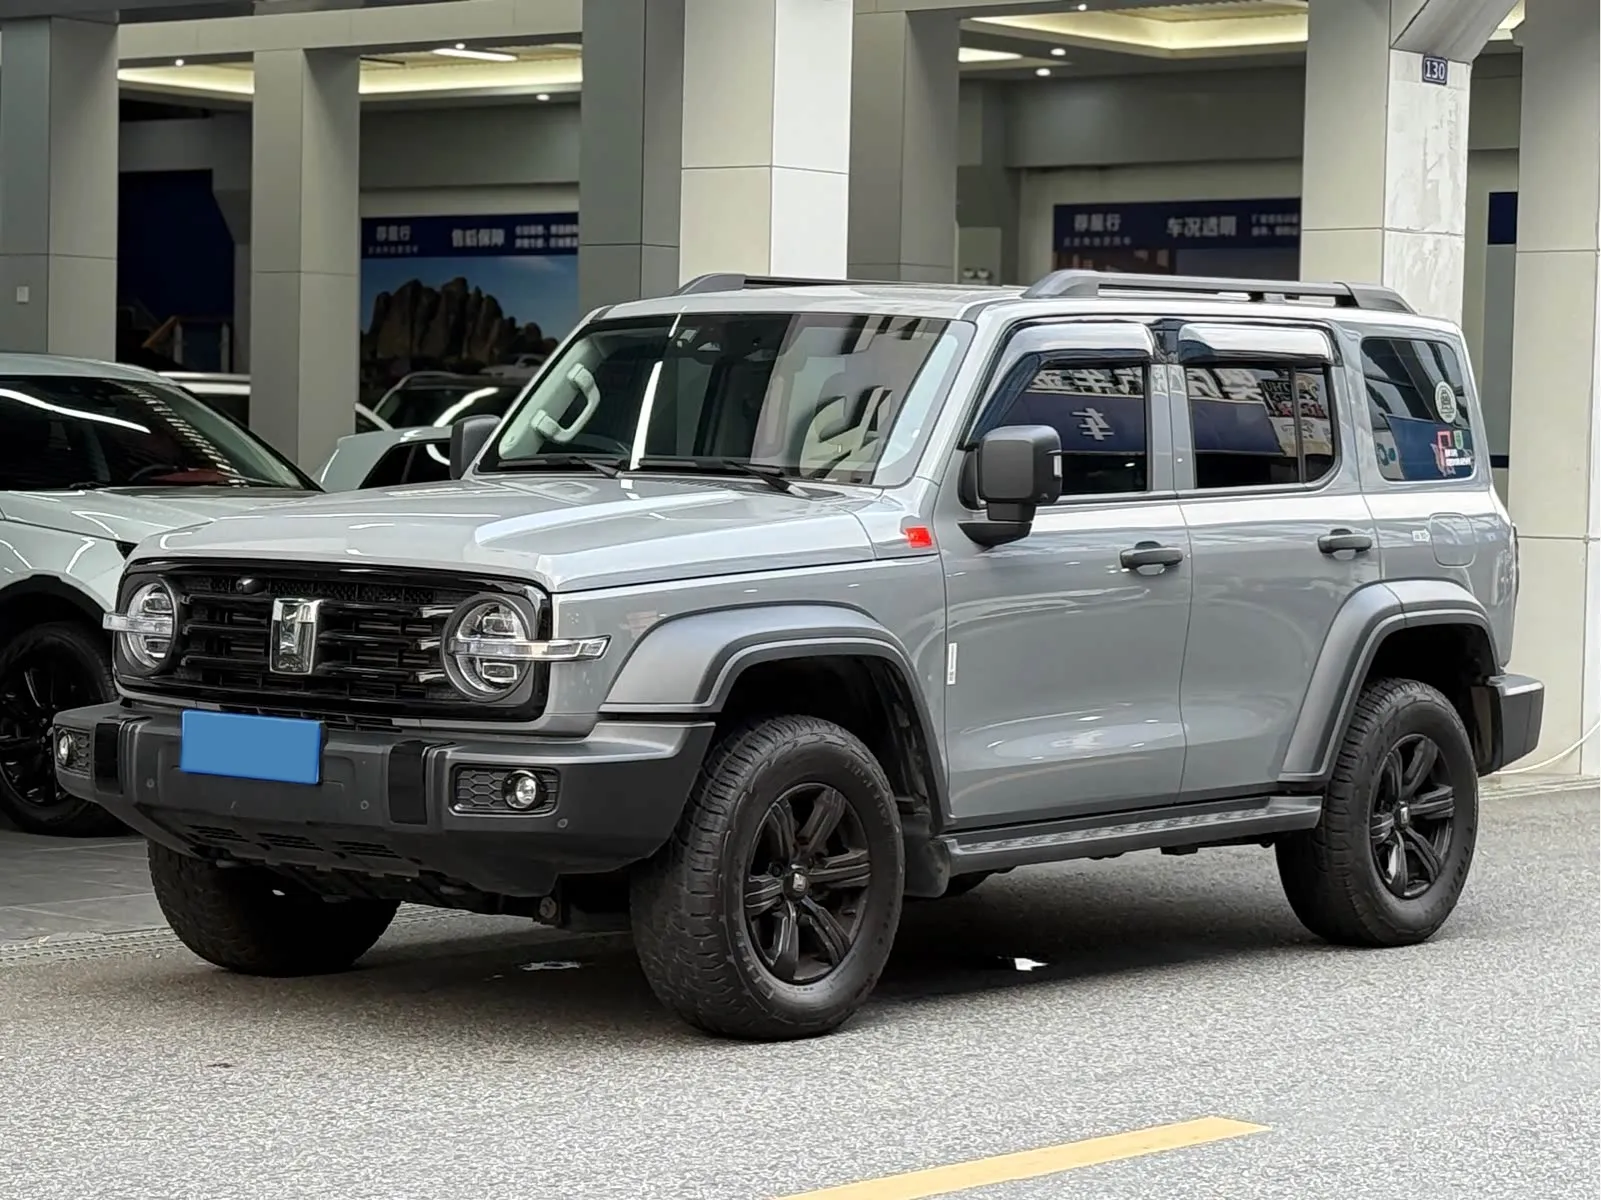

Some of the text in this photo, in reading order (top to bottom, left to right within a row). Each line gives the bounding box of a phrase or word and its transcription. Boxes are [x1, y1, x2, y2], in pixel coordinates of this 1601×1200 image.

[1425, 61, 1445, 80] 130
[1166, 215, 1237, 237] 车况透明
